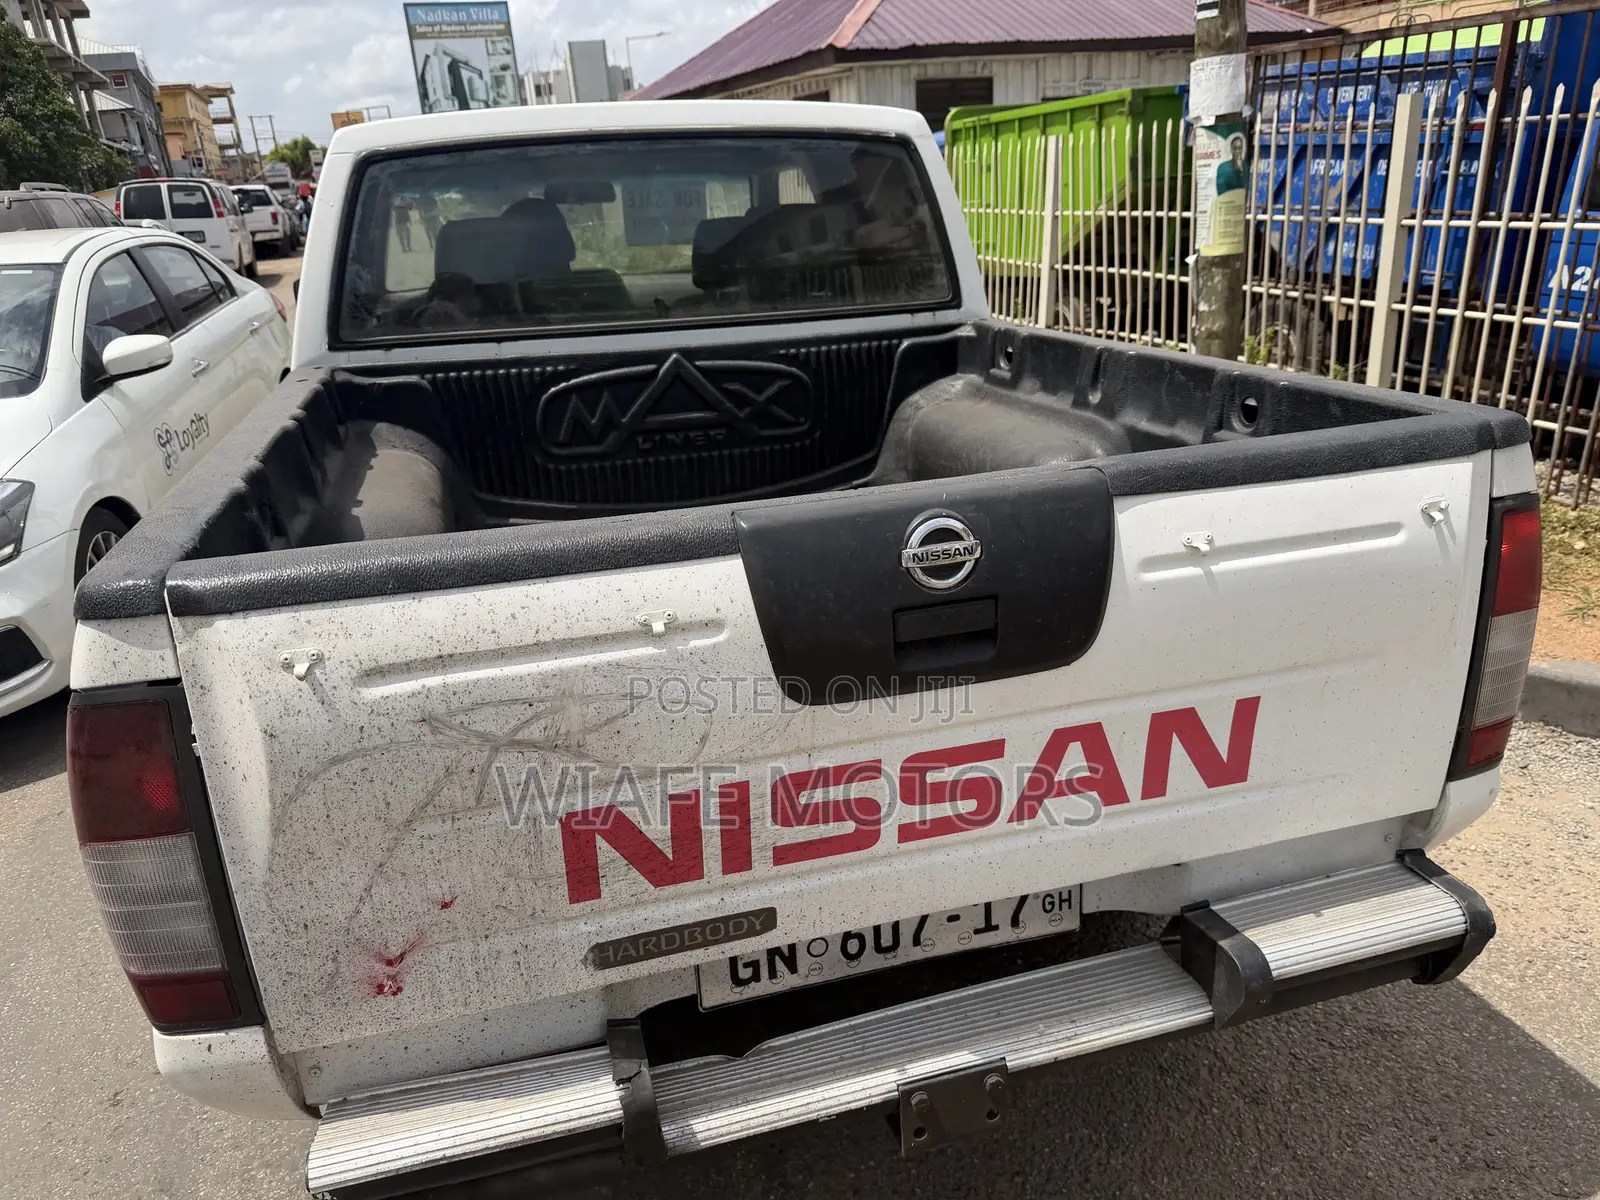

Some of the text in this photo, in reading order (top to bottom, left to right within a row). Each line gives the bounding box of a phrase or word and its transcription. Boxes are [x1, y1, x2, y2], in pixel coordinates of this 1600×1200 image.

[470, 7, 500, 20] Villa
[559, 352, 794, 443] MAX
[911, 545, 975, 563] NISSAN
[562, 696, 1261, 904] NISSAN
[600, 911, 768, 964] HARDBODY
[728, 942, 798, 987] GN
[1042, 890, 1072, 914] GH
